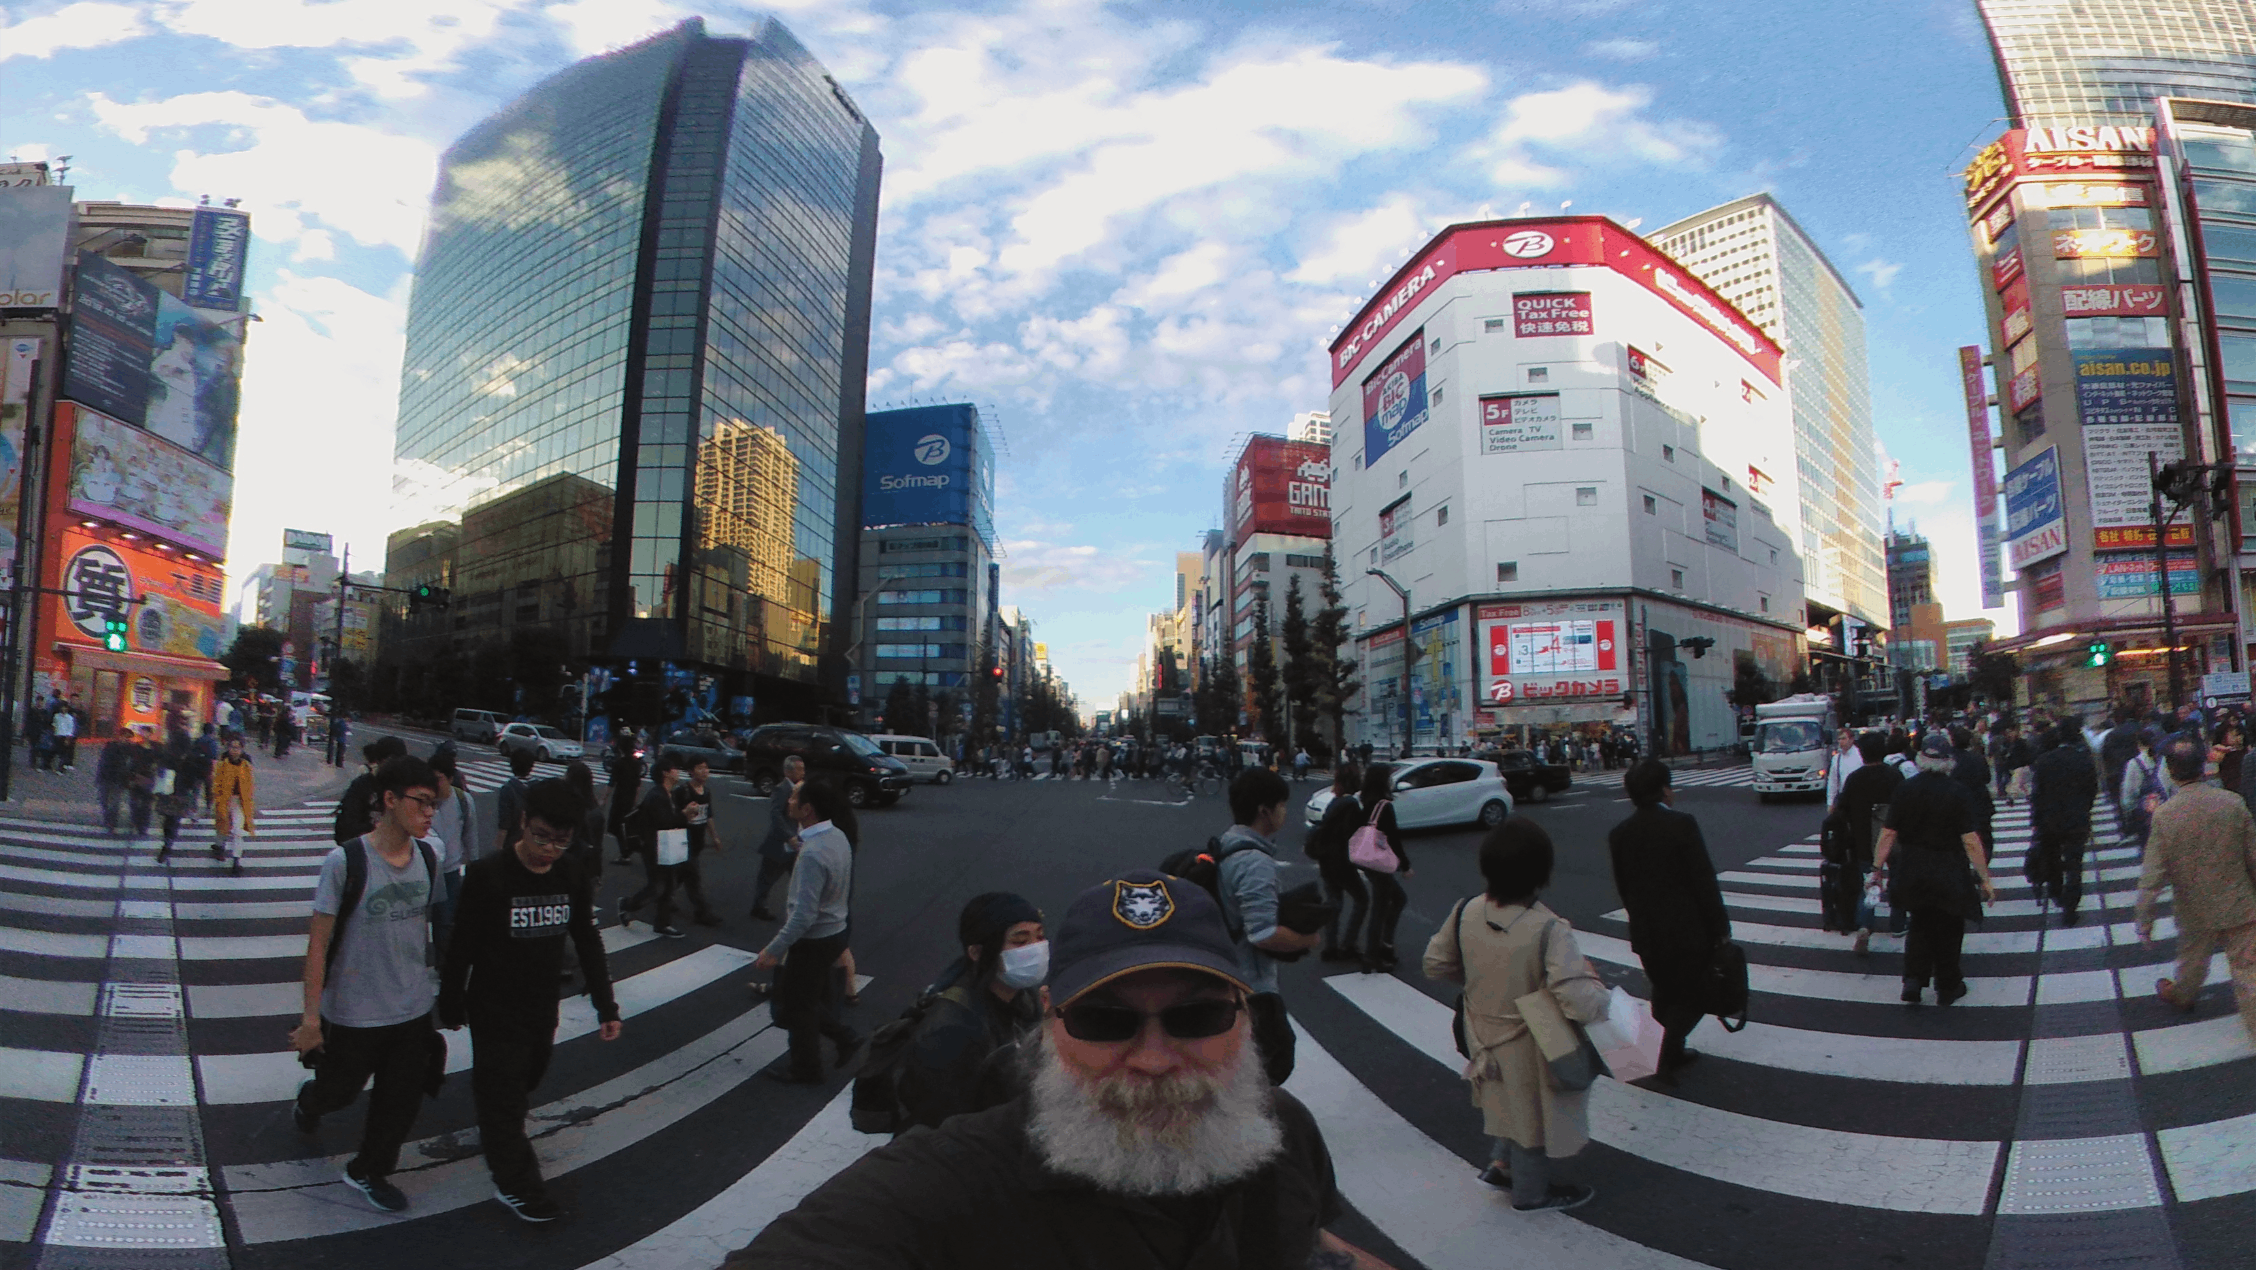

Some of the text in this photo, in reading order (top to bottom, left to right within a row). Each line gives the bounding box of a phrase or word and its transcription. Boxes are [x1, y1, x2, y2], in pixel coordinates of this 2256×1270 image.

[2023, 126, 2152, 153] AISAN
[1517, 298, 1576, 310] QUICK
[2065, 289, 2163, 312] 配線パーツ
[1339, 264, 1438, 370] BIC CAMERA
[1518, 308, 1590, 320] Tax Free
[1519, 321, 1590, 334] 快速免税
[1366, 338, 1422, 395] BicCamera
[2080, 360, 2171, 377] aisan.co.jp
[1382, 382, 1405, 412] BIC
[1513, 399, 1538, 407] カメラ
[1485, 403, 1509, 420] 5F
[1513, 407, 1538, 415] テレビ
[1387, 408, 1428, 448] Sofmap
[1488, 428, 1523, 436] Camera
[1489, 434, 1555, 444] Video Camera
[880, 473, 950, 490] Sofmap
[1480, 607, 1520, 618] Tax Free
[1522, 678, 1620, 698] ビックカメラ
[510, 903, 571, 929] EST.1960
